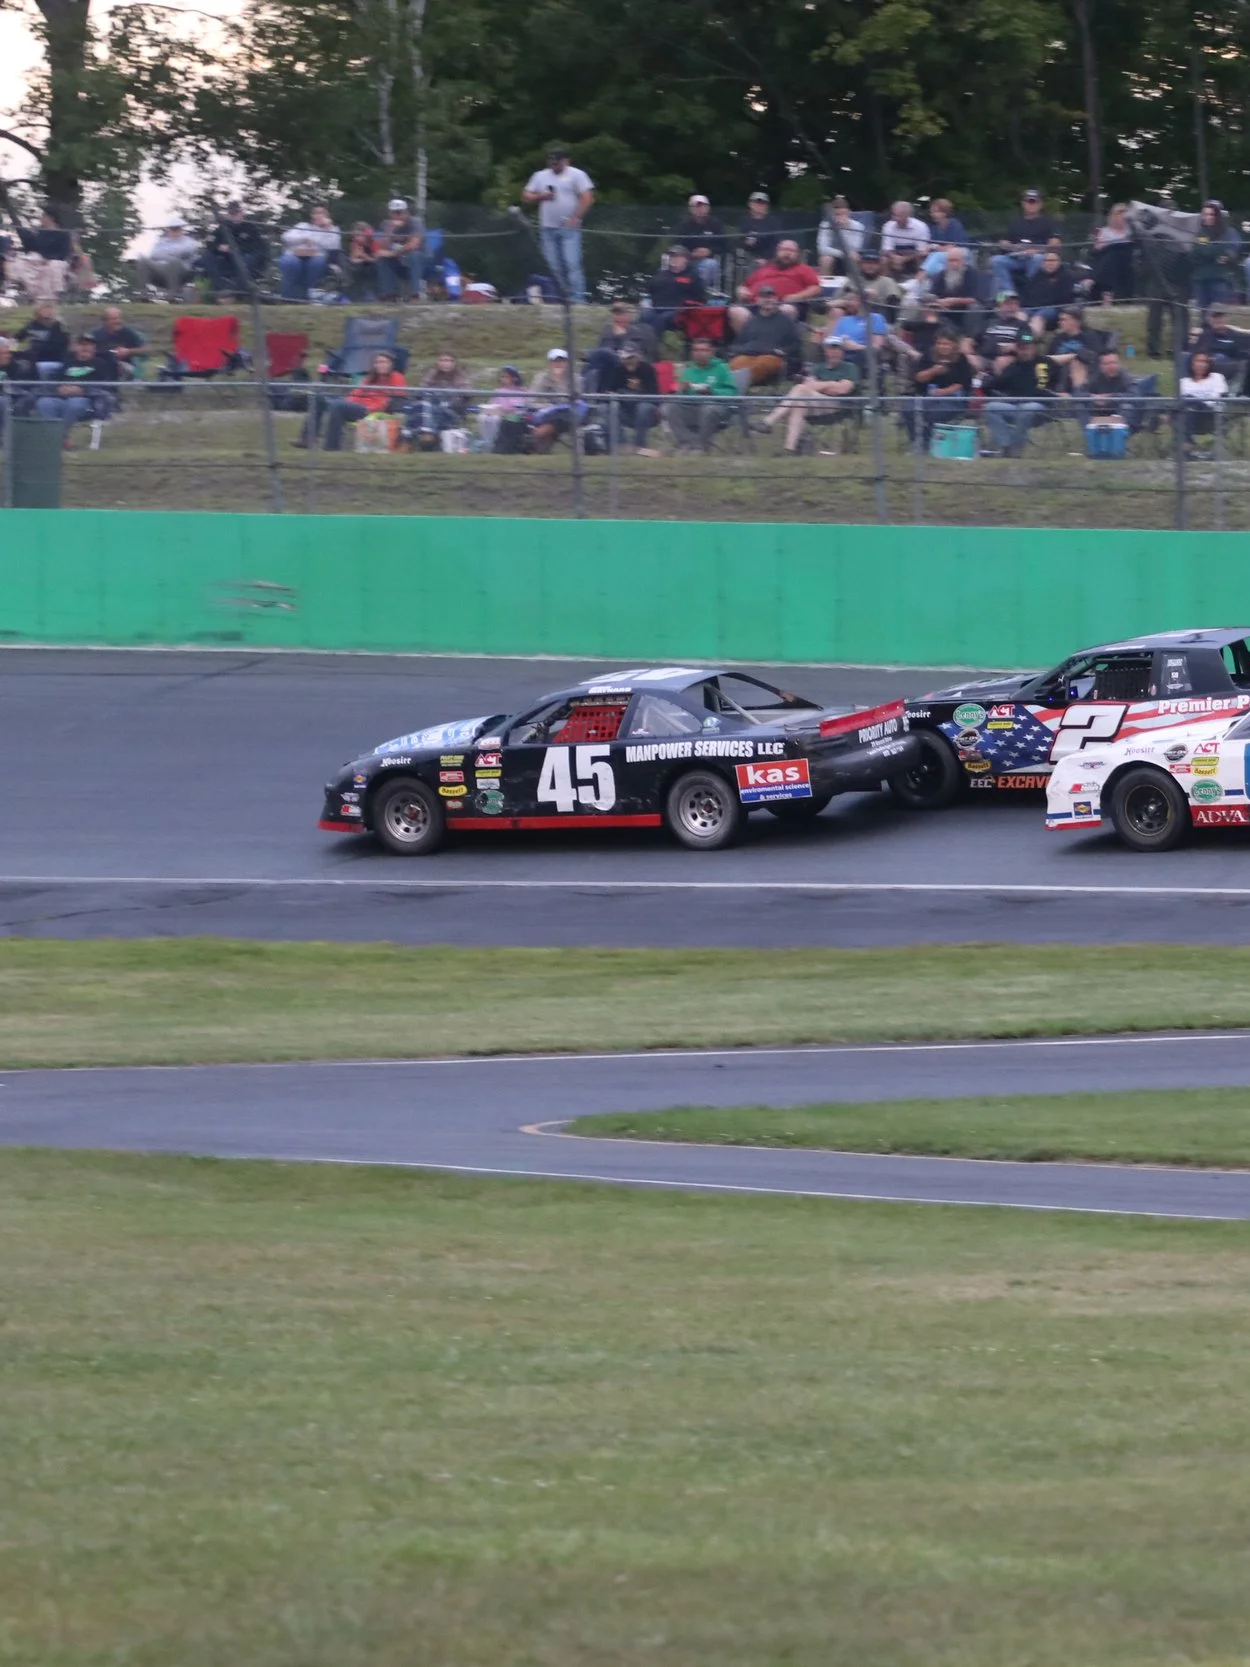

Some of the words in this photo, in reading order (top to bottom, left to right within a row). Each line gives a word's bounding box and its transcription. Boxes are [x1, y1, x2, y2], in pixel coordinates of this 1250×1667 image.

[1158, 697, 1233, 714] Premier
[1050, 703, 1128, 765] 2
[626, 742, 692, 763] MANPOWER
[694, 740, 754, 758] SERVICES
[1193, 742, 1220, 755] ACT
[537, 744, 617, 812] 45
[746, 766, 800, 785] kas
[997, 775, 1052, 789] EXCAV
